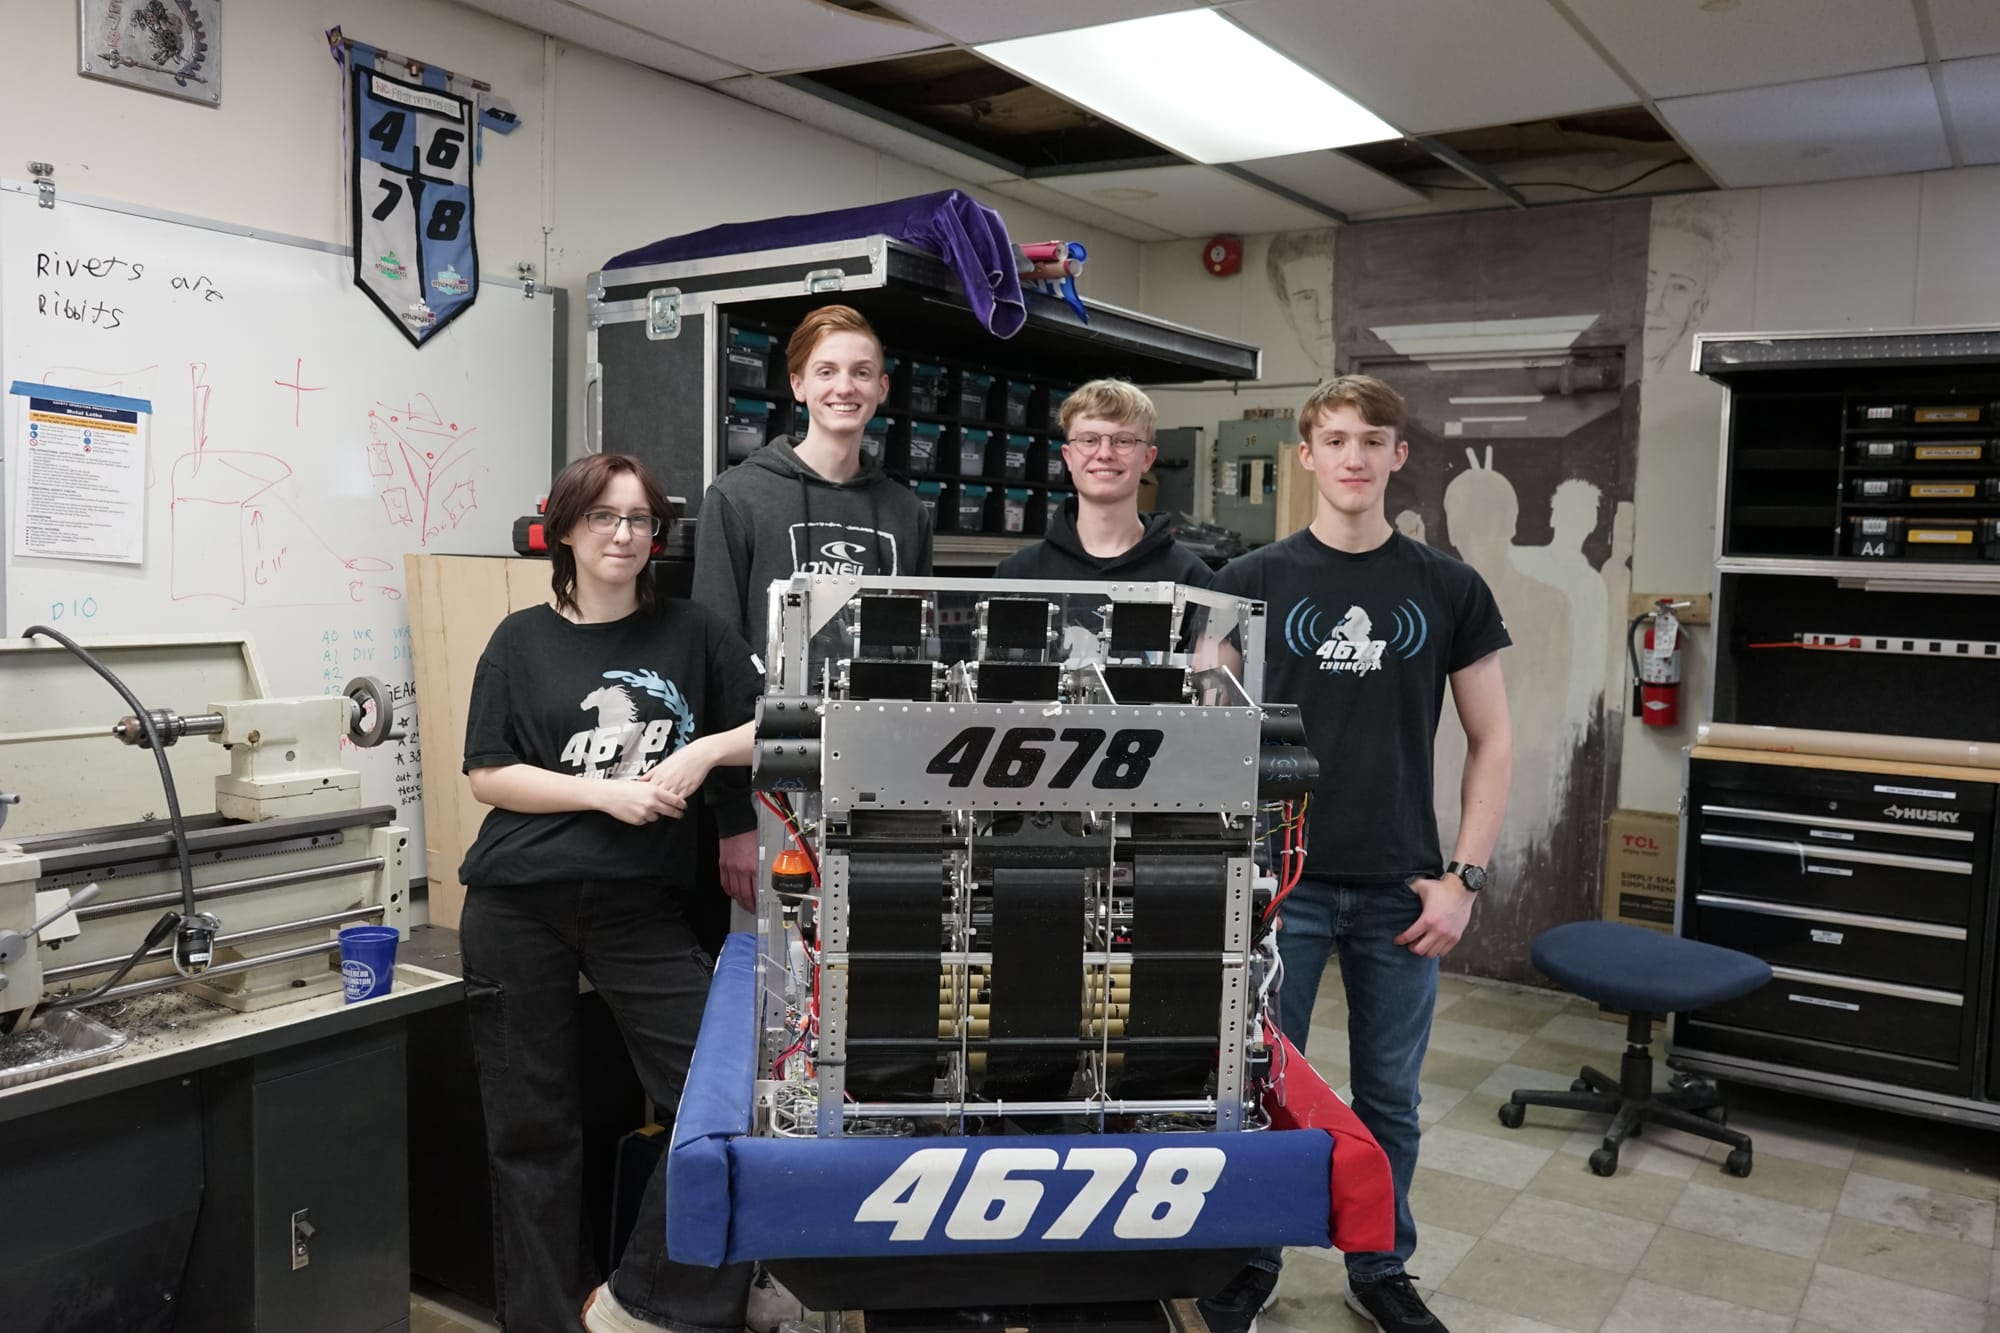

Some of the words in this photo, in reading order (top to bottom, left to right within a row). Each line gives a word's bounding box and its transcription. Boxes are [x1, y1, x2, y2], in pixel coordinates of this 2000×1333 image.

[369, 111, 406, 153] 4
[426, 127, 465, 170] 6
[371, 178, 403, 222] 7
[426, 199, 466, 242] 8
[37, 251, 144, 281] Rivets
[66, 408, 85, 416] Metal
[1861, 541, 1885, 556] A4
[1316, 640, 1387, 660] 4678
[560, 719, 673, 767] 4678
[926, 727, 1164, 789] 4678
[1903, 807, 1960, 824] HUSKY
[1622, 834, 1658, 849] TCL
[1621, 871, 1653, 882] SIMPLY
[854, 1148, 1226, 1241] 4678
